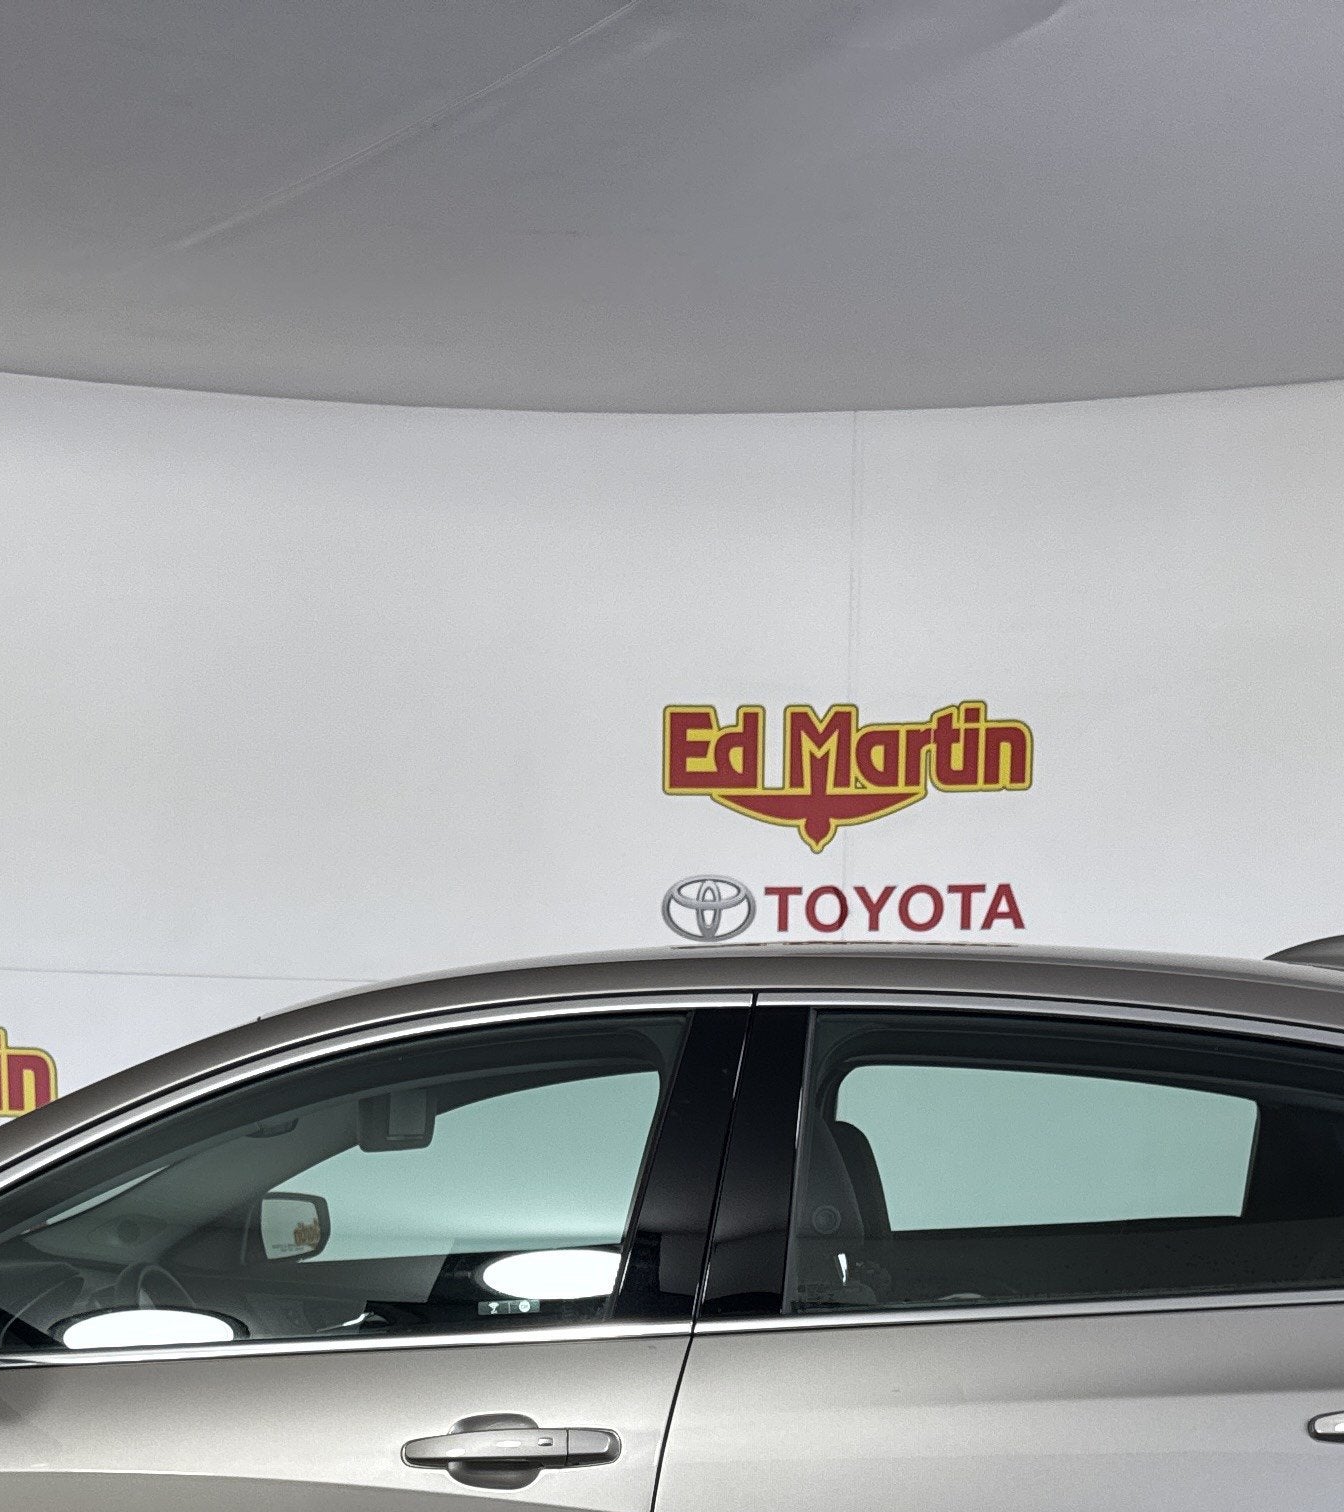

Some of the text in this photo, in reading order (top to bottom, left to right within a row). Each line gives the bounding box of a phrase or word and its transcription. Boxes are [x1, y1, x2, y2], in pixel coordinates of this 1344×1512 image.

[665, 703, 1030, 793] Ed Martin
[764, 883, 1027, 934] TOYOTA
